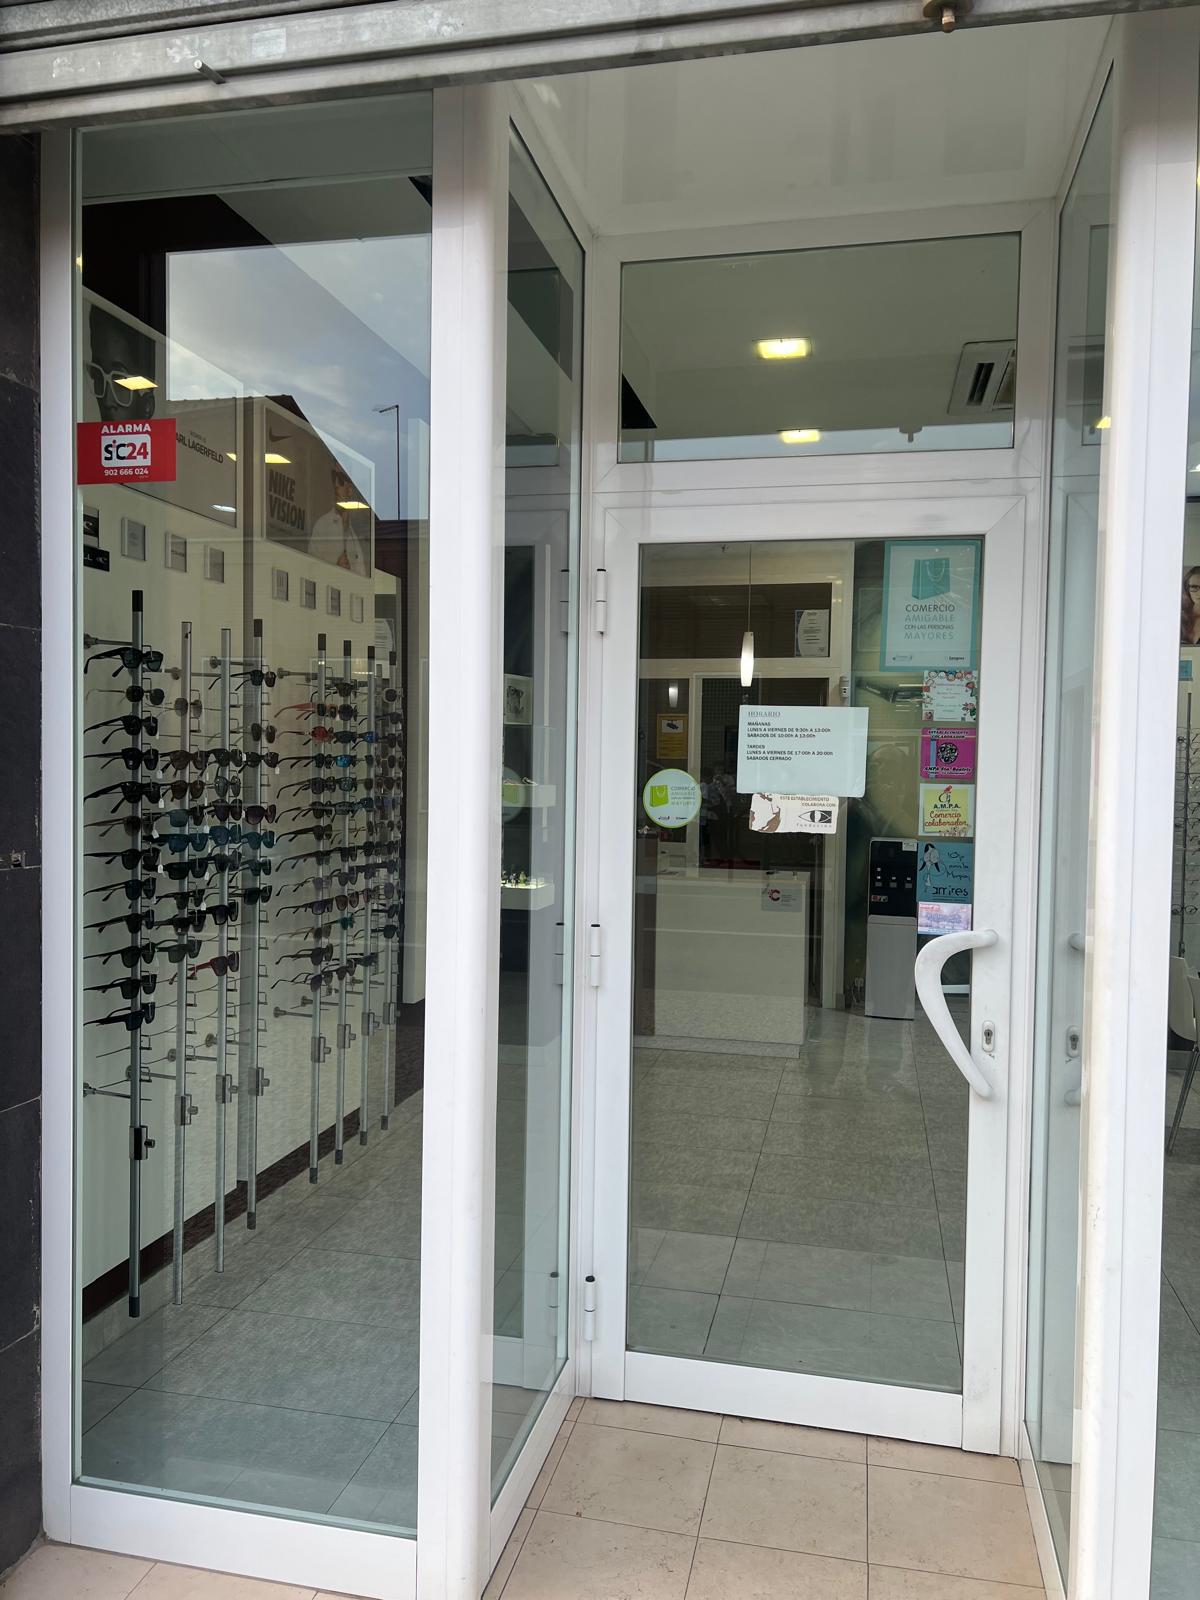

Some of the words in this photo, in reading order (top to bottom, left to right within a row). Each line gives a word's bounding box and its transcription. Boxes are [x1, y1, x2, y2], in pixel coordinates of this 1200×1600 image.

[101, 423, 152, 434] ALARMA
[188, 438, 224, 464] LAGERFELD
[119, 468, 133, 476] 666
[134, 467, 149, 475] 024
[268, 468, 296, 502] NIKE
[269, 493, 306, 531] VISION
[905, 603, 956, 612] COMERCIO
[904, 614, 956, 622] AMIGABLE
[904, 632, 954, 640] MAYORES
[929, 810, 962, 819] Comercio
